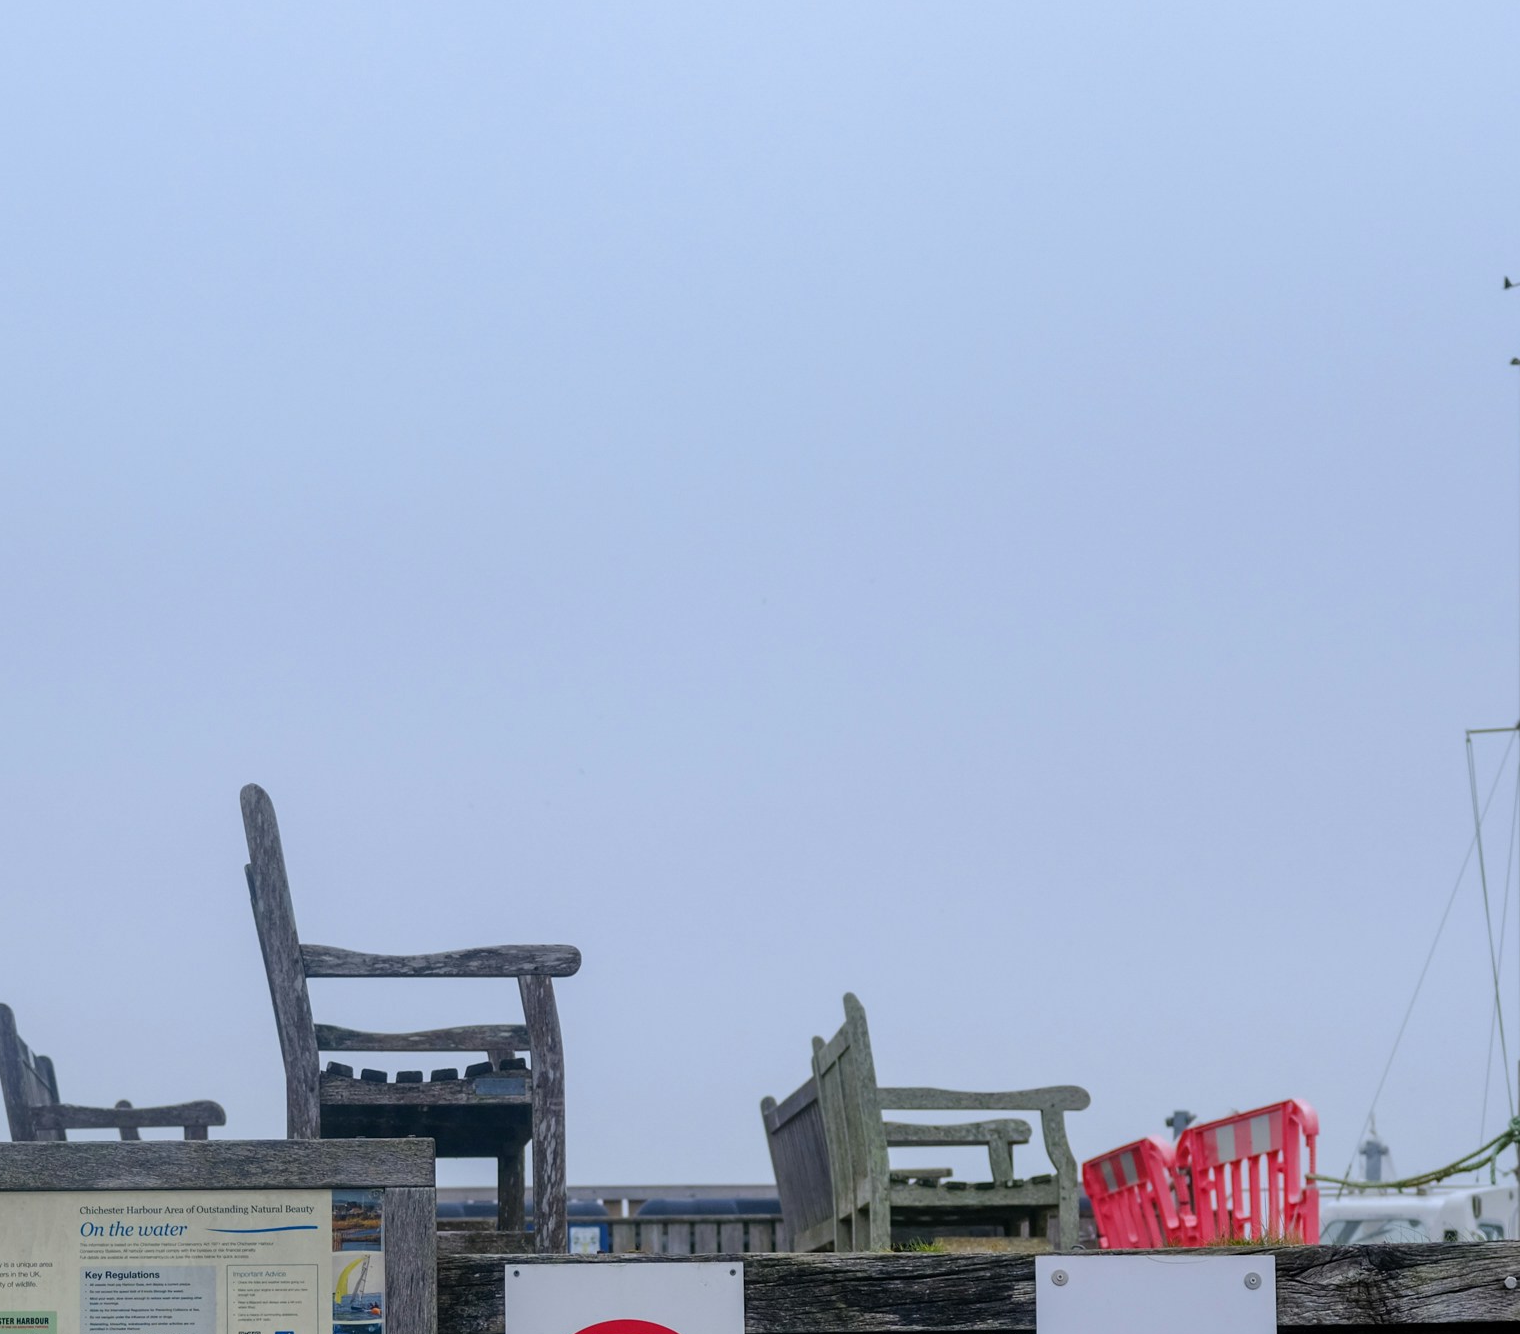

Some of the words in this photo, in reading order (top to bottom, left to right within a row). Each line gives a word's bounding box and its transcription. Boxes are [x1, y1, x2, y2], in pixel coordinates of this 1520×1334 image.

[80, 1206, 124, 1214] Chichester
[126, 1205, 163, 1214] Harbour
[164, 1206, 184, 1214] Area
[185, 1205, 195, 1214] of
[196, 1205, 249, 1215] Outstanding
[251, 1205, 282, 1213] Natural
[286, 1205, 314, 1215] Beauty
[80, 1221, 104, 1237] On
[109, 1221, 134, 1237] the
[138, 1223, 188, 1237] water
[85, 1271, 102, 1280] Key
[105, 1271, 160, 1280] Regulations
[16, 1317, 49, 1325] HARBOUR
